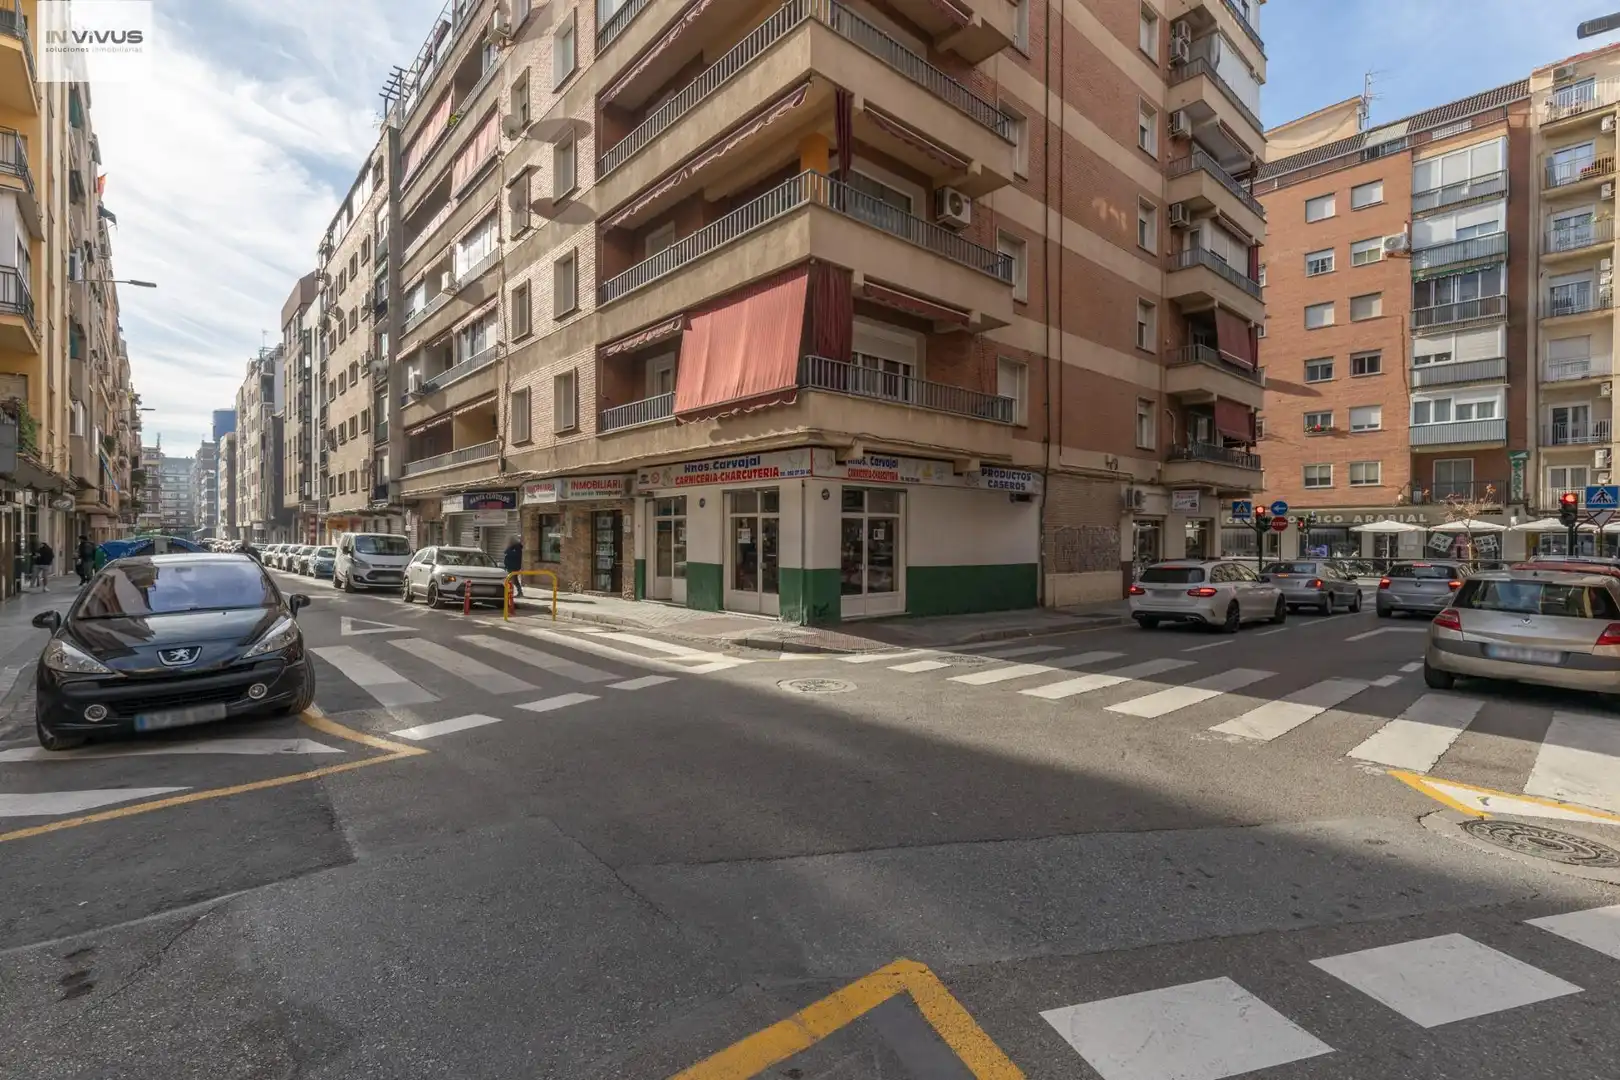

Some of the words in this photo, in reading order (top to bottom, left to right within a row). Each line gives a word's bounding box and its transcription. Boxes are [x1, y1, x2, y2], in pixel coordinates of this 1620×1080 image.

[713, 456, 761, 470] Carvajal
[870, 456, 898, 469] Carvajal
[981, 467, 1032, 481] PRODUCTOS
[571, 480, 623, 490] INMOBILIARI
[987, 479, 1026, 491] CASEROS
[1288, 514, 1343, 523] OICO
[1353, 513, 1427, 523] ARABIAL
